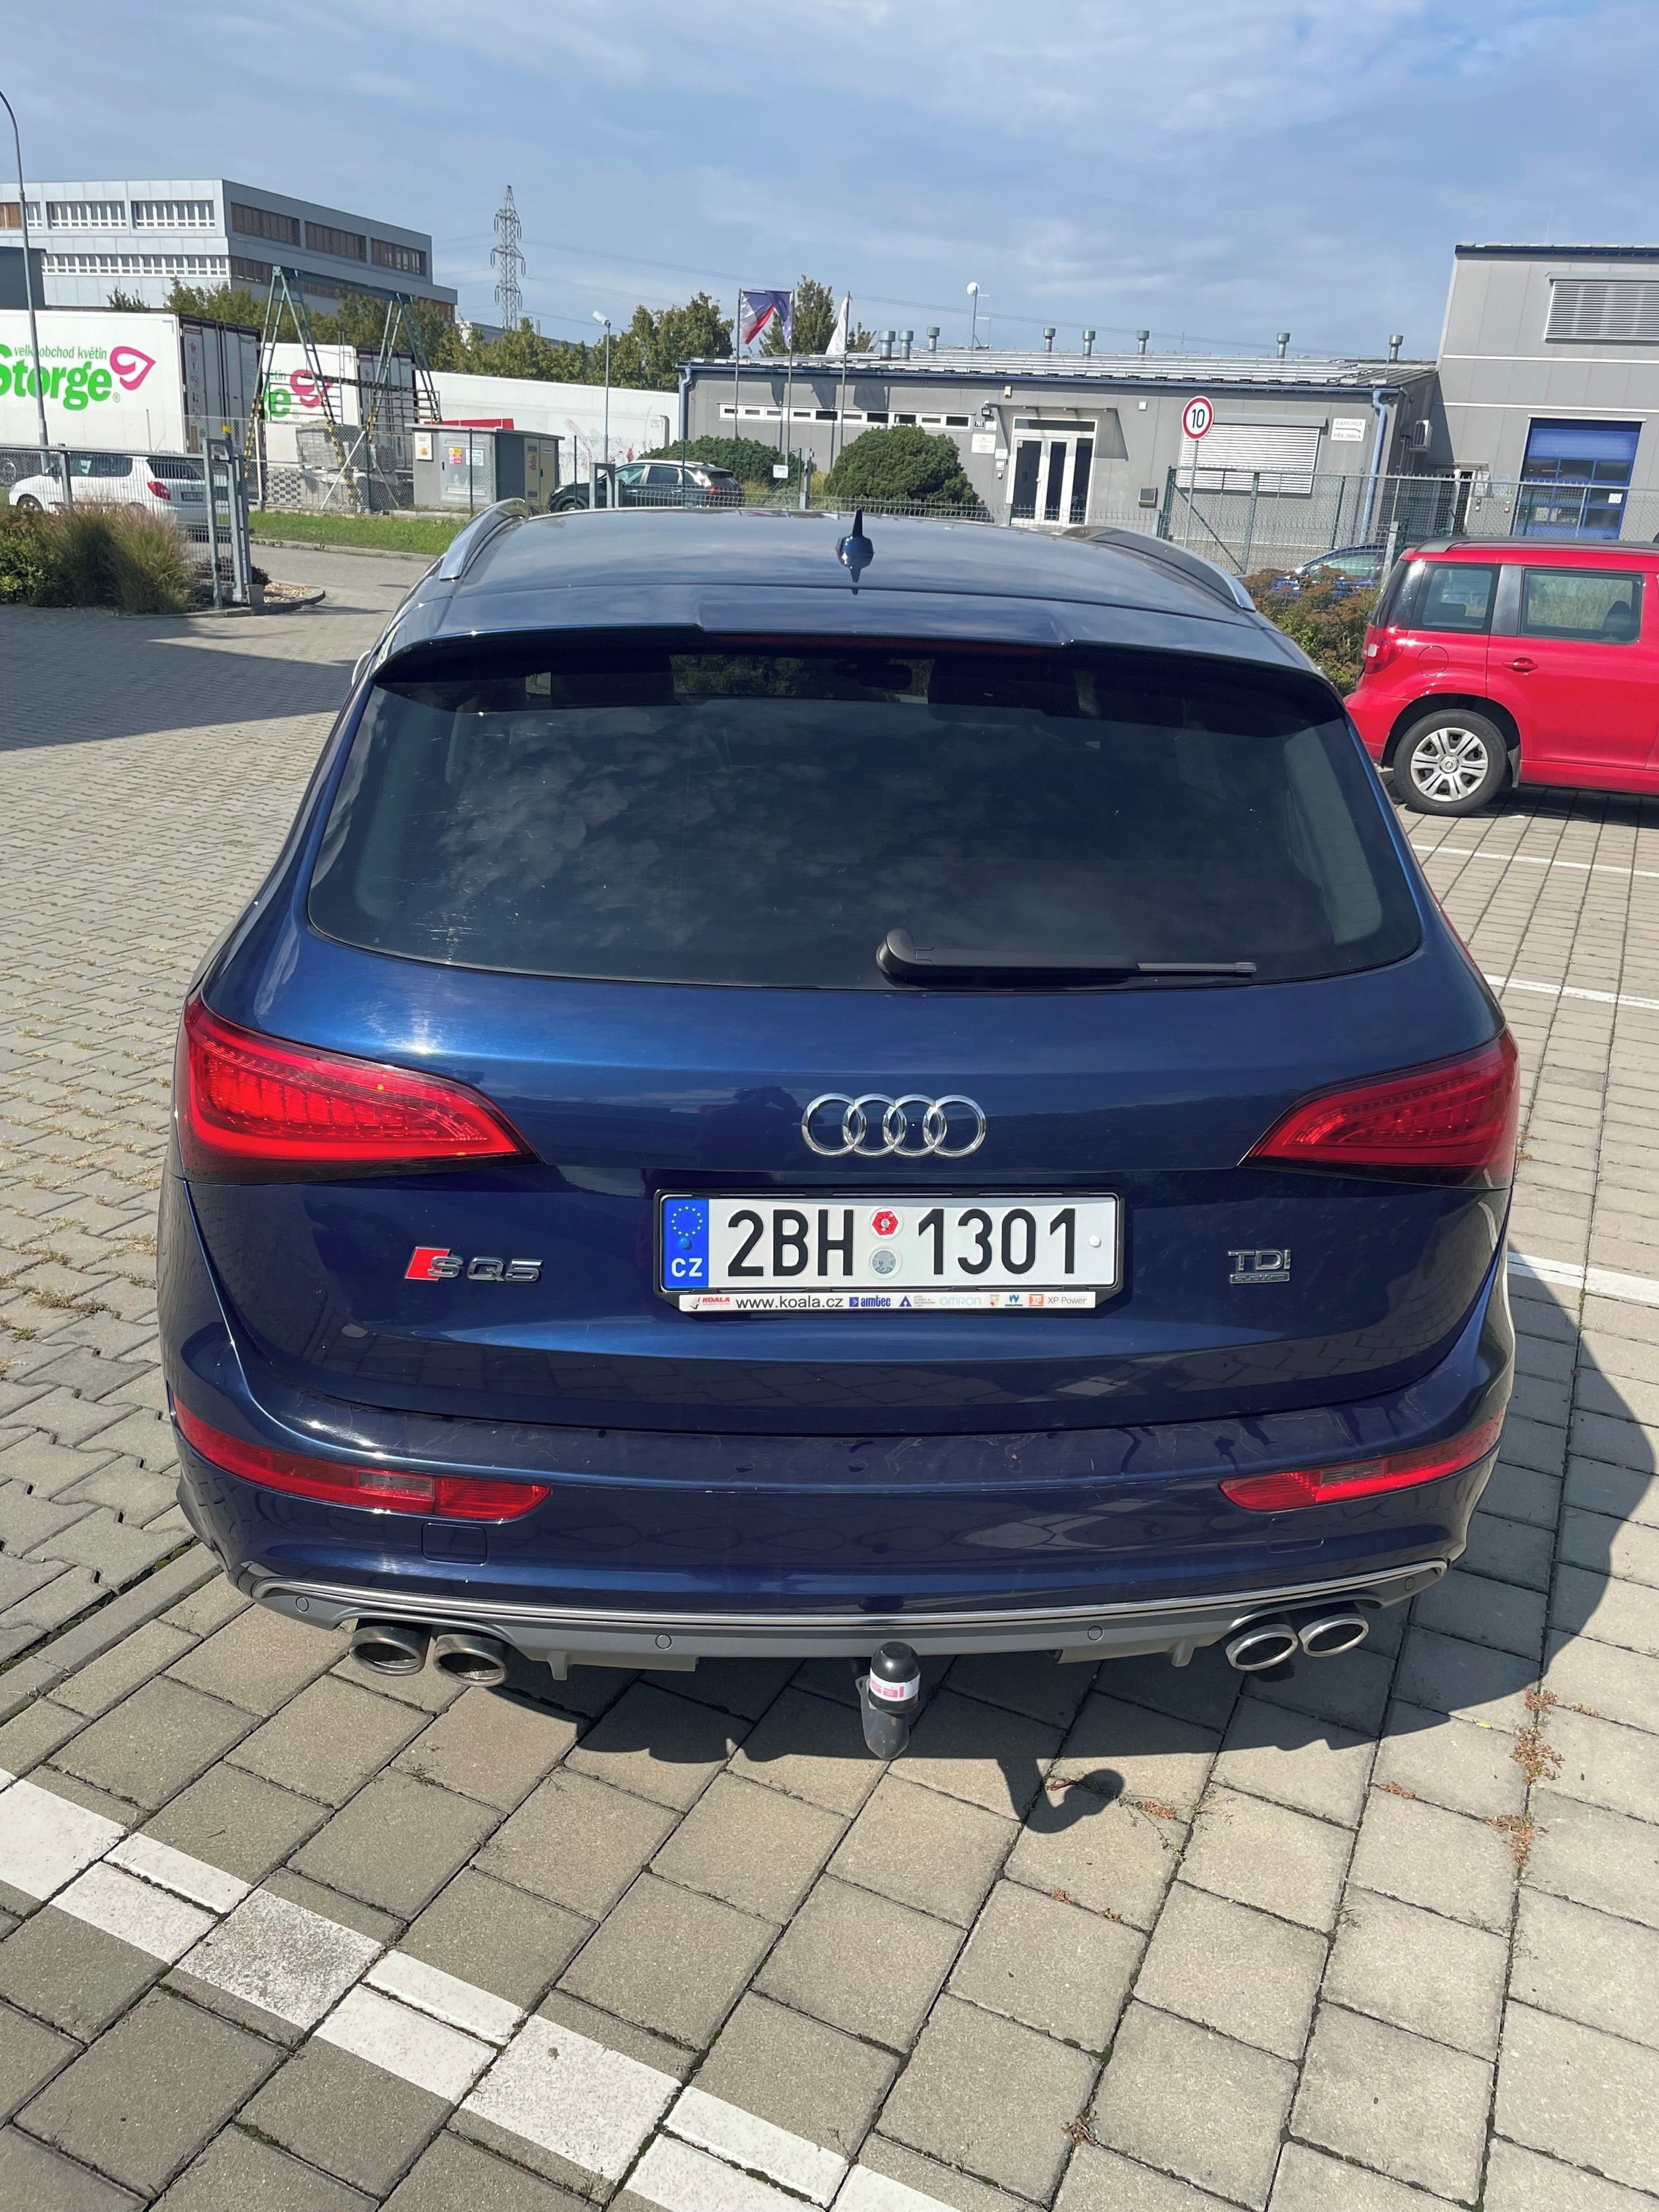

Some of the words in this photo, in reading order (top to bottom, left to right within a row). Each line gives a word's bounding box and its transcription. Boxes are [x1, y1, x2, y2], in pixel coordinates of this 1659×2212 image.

[14, 345, 75, 358] velkobchod
[78, 347, 108, 360] květin
[1192, 409, 1205, 428] 10
[727, 1208, 854, 1277] 2BH
[917, 1208, 1075, 1275] 1301
[671, 1257, 703, 1277] CZ
[1228, 1249, 1291, 1271] TDI
[736, 1295, 843, 1308] www.koala.cz
